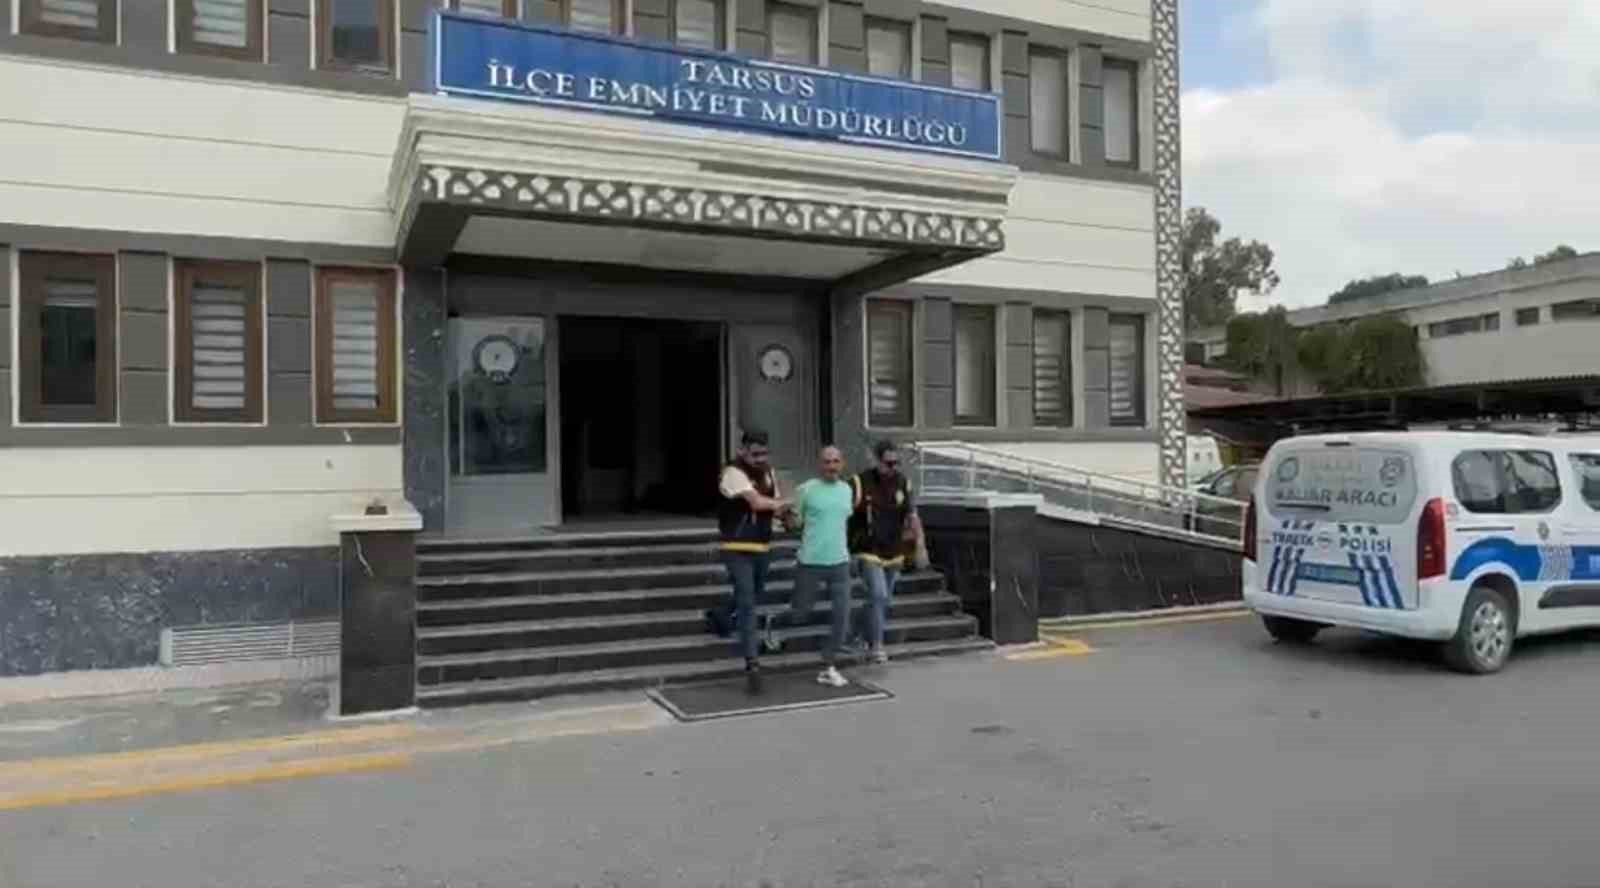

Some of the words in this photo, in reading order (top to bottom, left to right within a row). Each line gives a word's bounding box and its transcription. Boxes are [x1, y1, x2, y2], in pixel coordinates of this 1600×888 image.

[487, 58, 575, 96] İLÇE
[588, 75, 755, 119] EMNİYET
[761, 102, 967, 146] MÜDÜRLÜĞÜ
[681, 59, 815, 98] TARSUS
